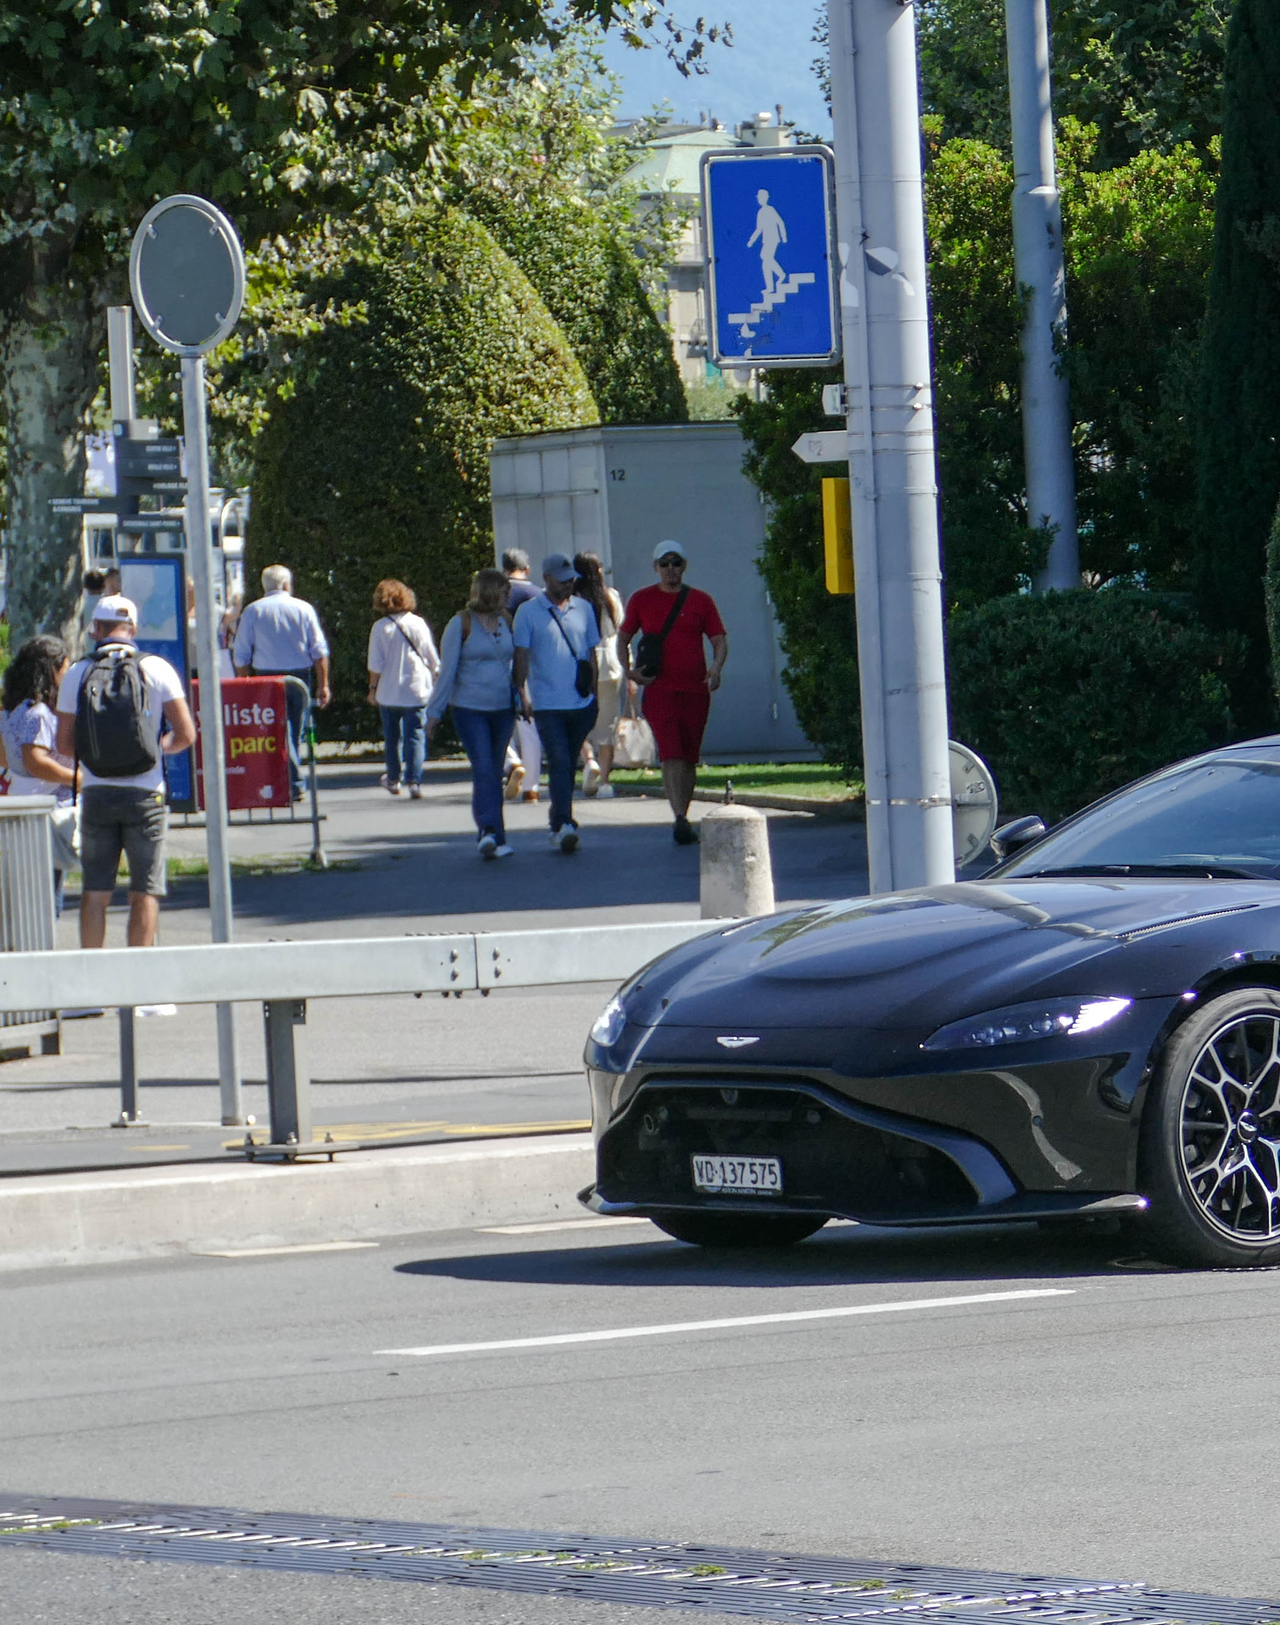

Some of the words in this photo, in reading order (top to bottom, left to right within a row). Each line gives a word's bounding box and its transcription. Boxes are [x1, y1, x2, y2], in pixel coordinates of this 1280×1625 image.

[610, 469, 625, 481] 12
[200, 703, 275, 726] liste
[230, 736, 277, 759] parc
